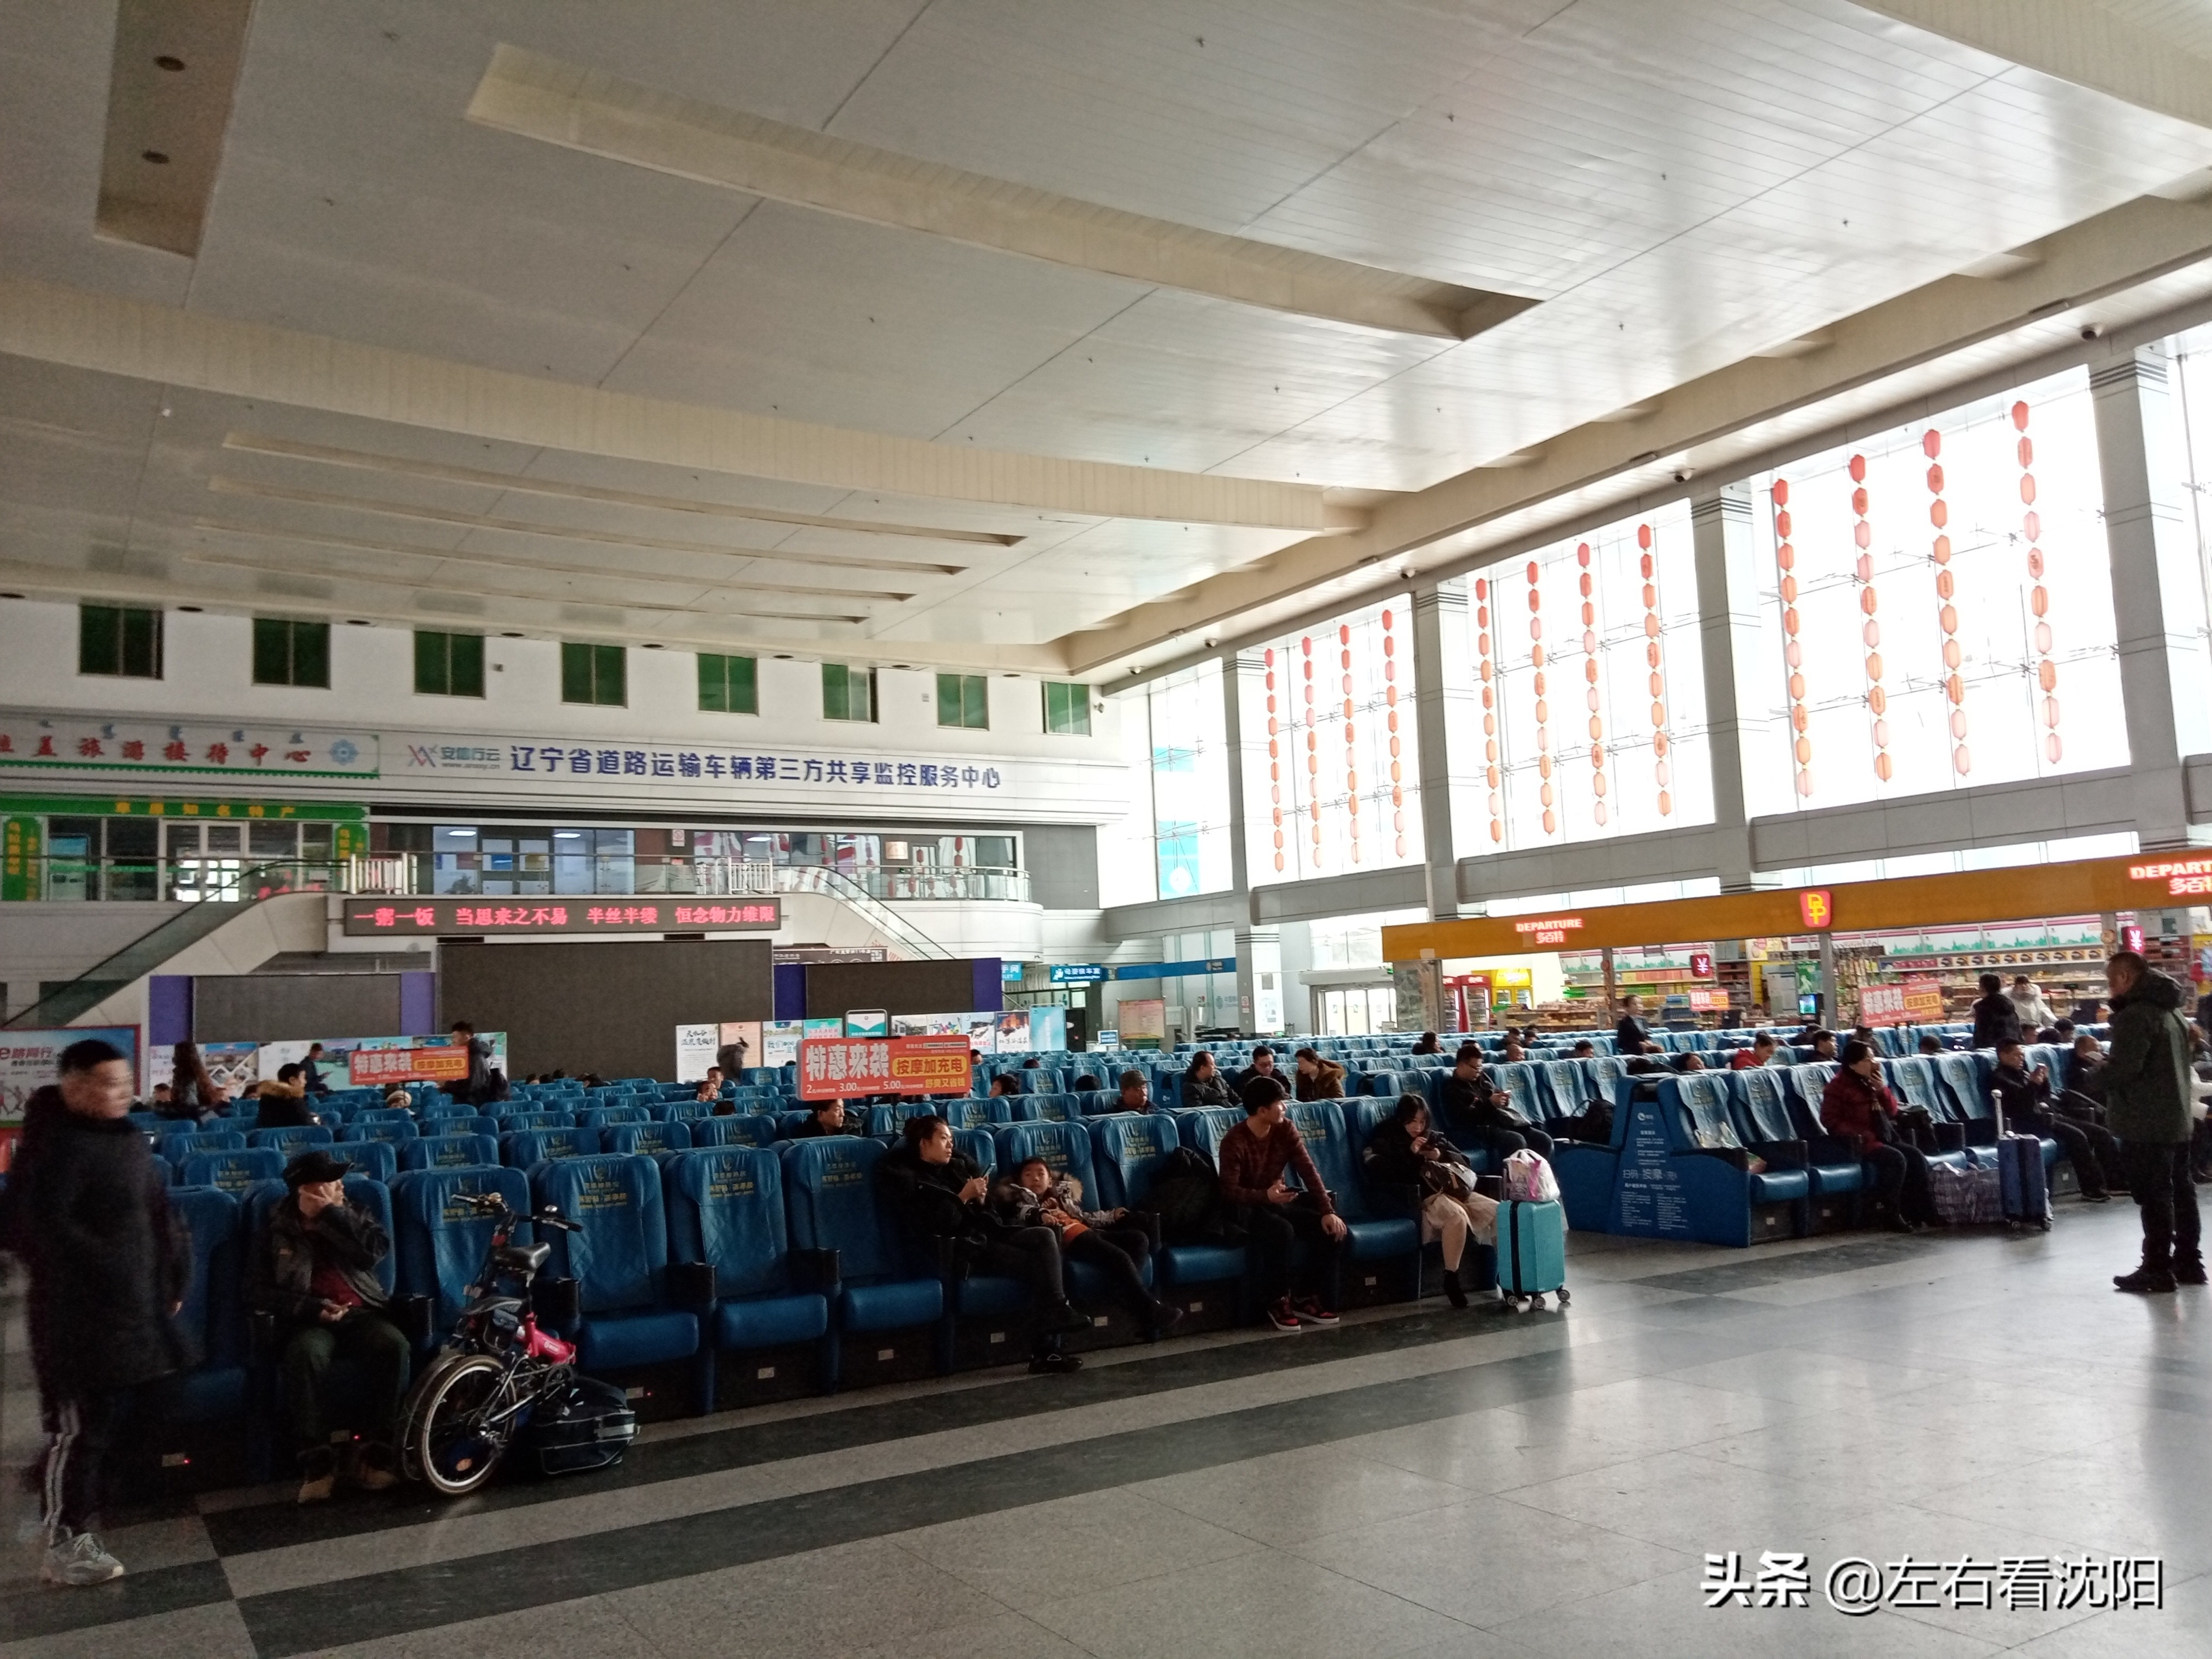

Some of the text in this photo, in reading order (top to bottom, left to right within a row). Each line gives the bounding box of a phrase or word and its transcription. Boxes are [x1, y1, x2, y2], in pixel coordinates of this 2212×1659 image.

[510, 745, 1001, 788] 辽宁省道路运输车辆第三方共享监控服务中心
[354, 907, 435, 926] 一粥一饭
[455, 907, 568, 926] 当思来之不易
[586, 907, 658, 925] 半丝半缕
[1515, 918, 1583, 932] DEPARTURE
[896, 1058, 963, 1075] 按摩加充电
